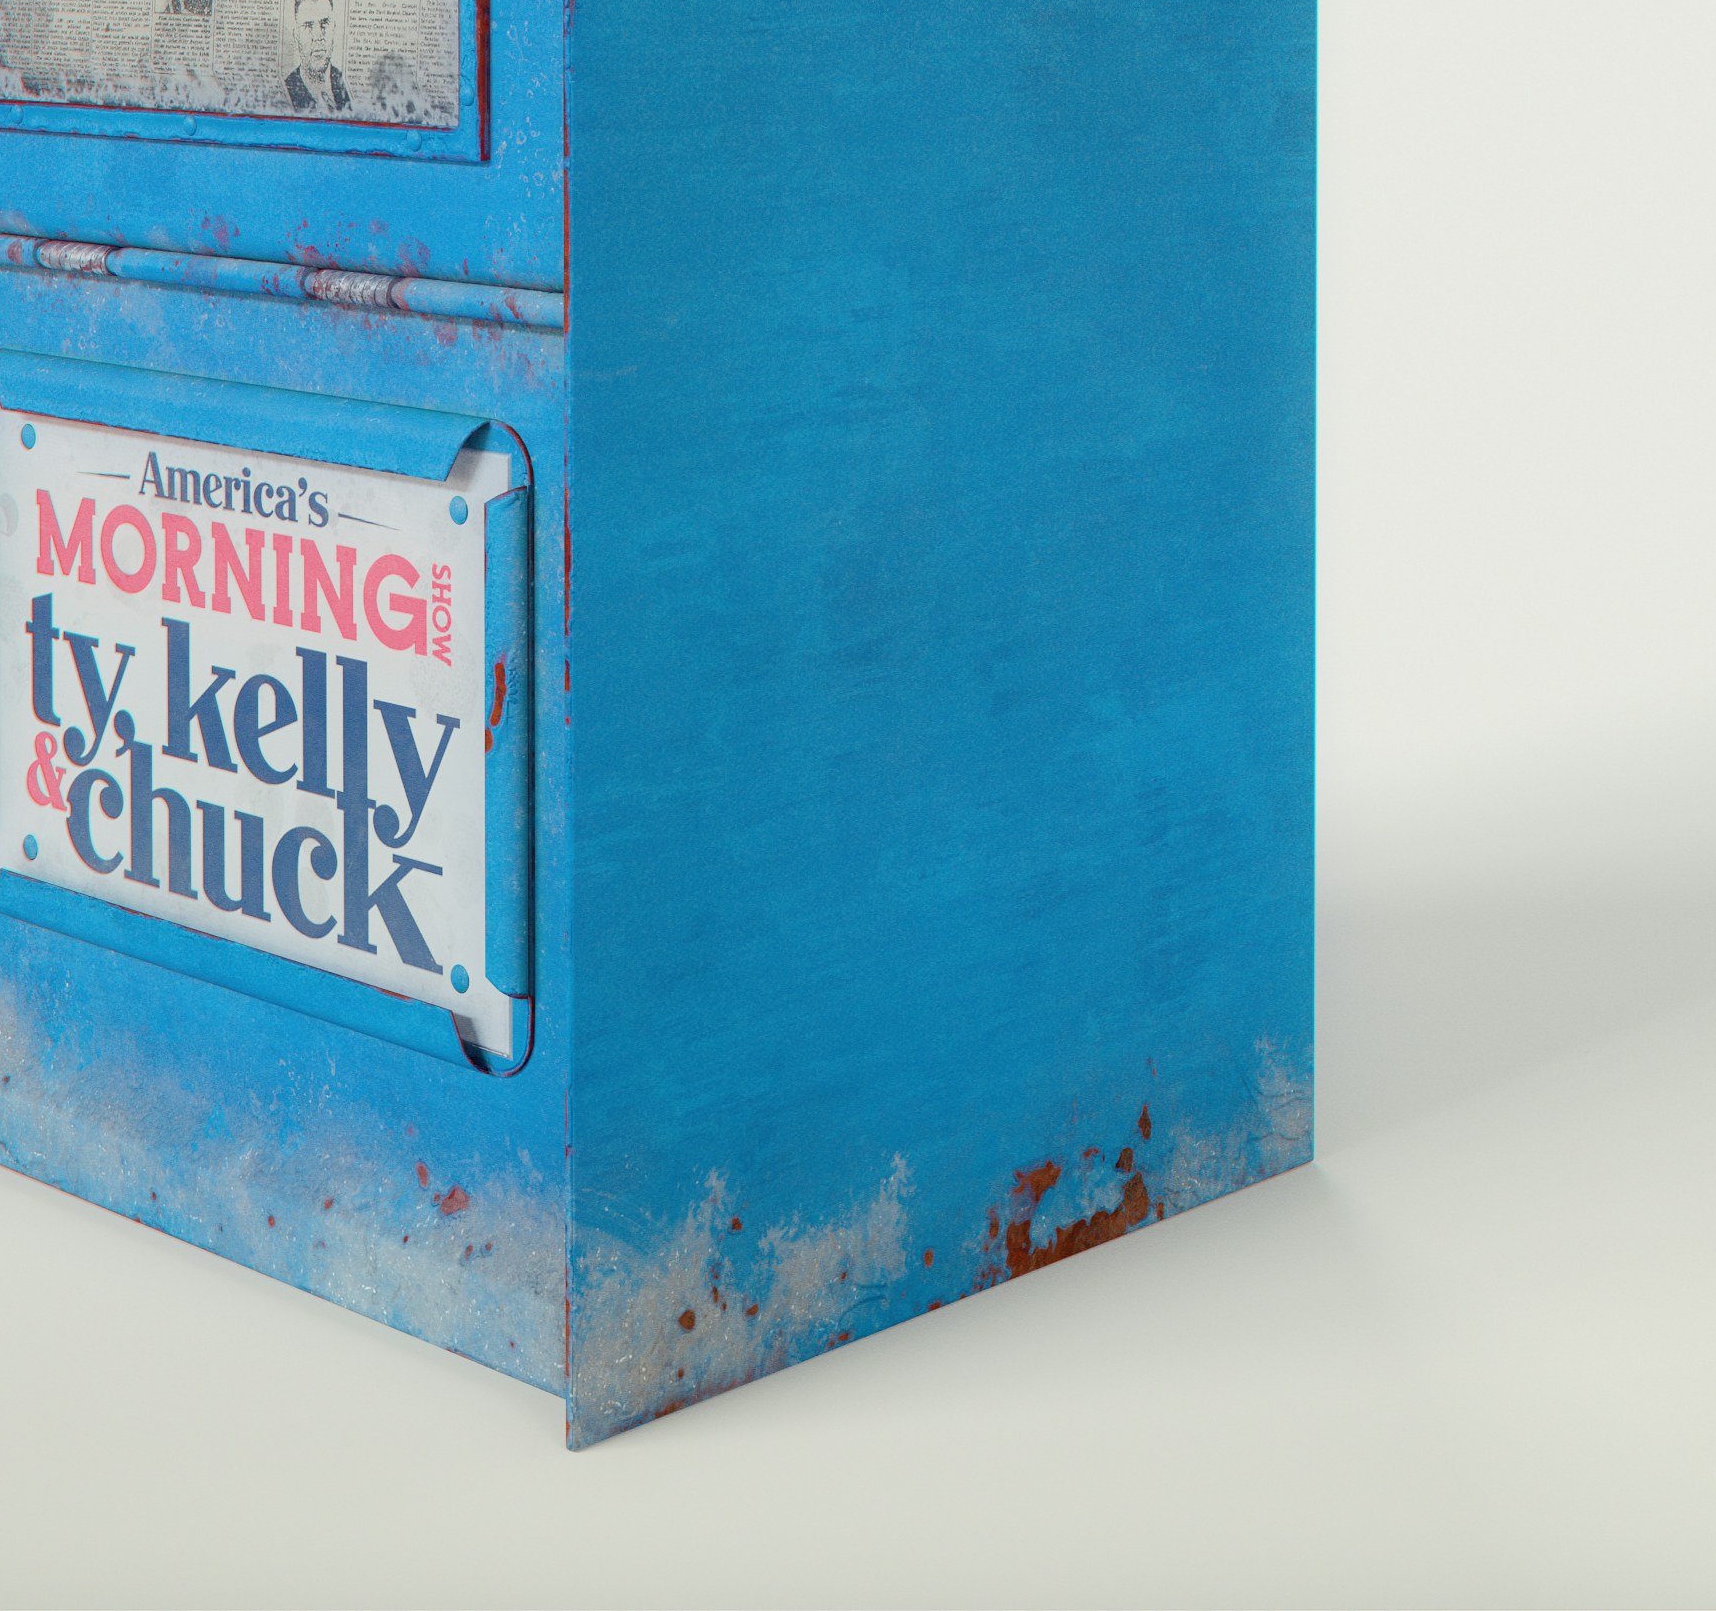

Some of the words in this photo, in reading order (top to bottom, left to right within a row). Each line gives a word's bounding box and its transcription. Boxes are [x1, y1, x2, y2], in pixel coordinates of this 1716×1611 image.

[35, 488, 428, 657] MORNING
[138, 451, 330, 528] America's
[431, 563, 452, 667] SHOW
[25, 592, 136, 766] ty,
[161, 617, 461, 849] kelly
[26, 730, 69, 817] &
[66, 740, 445, 975] chuck
